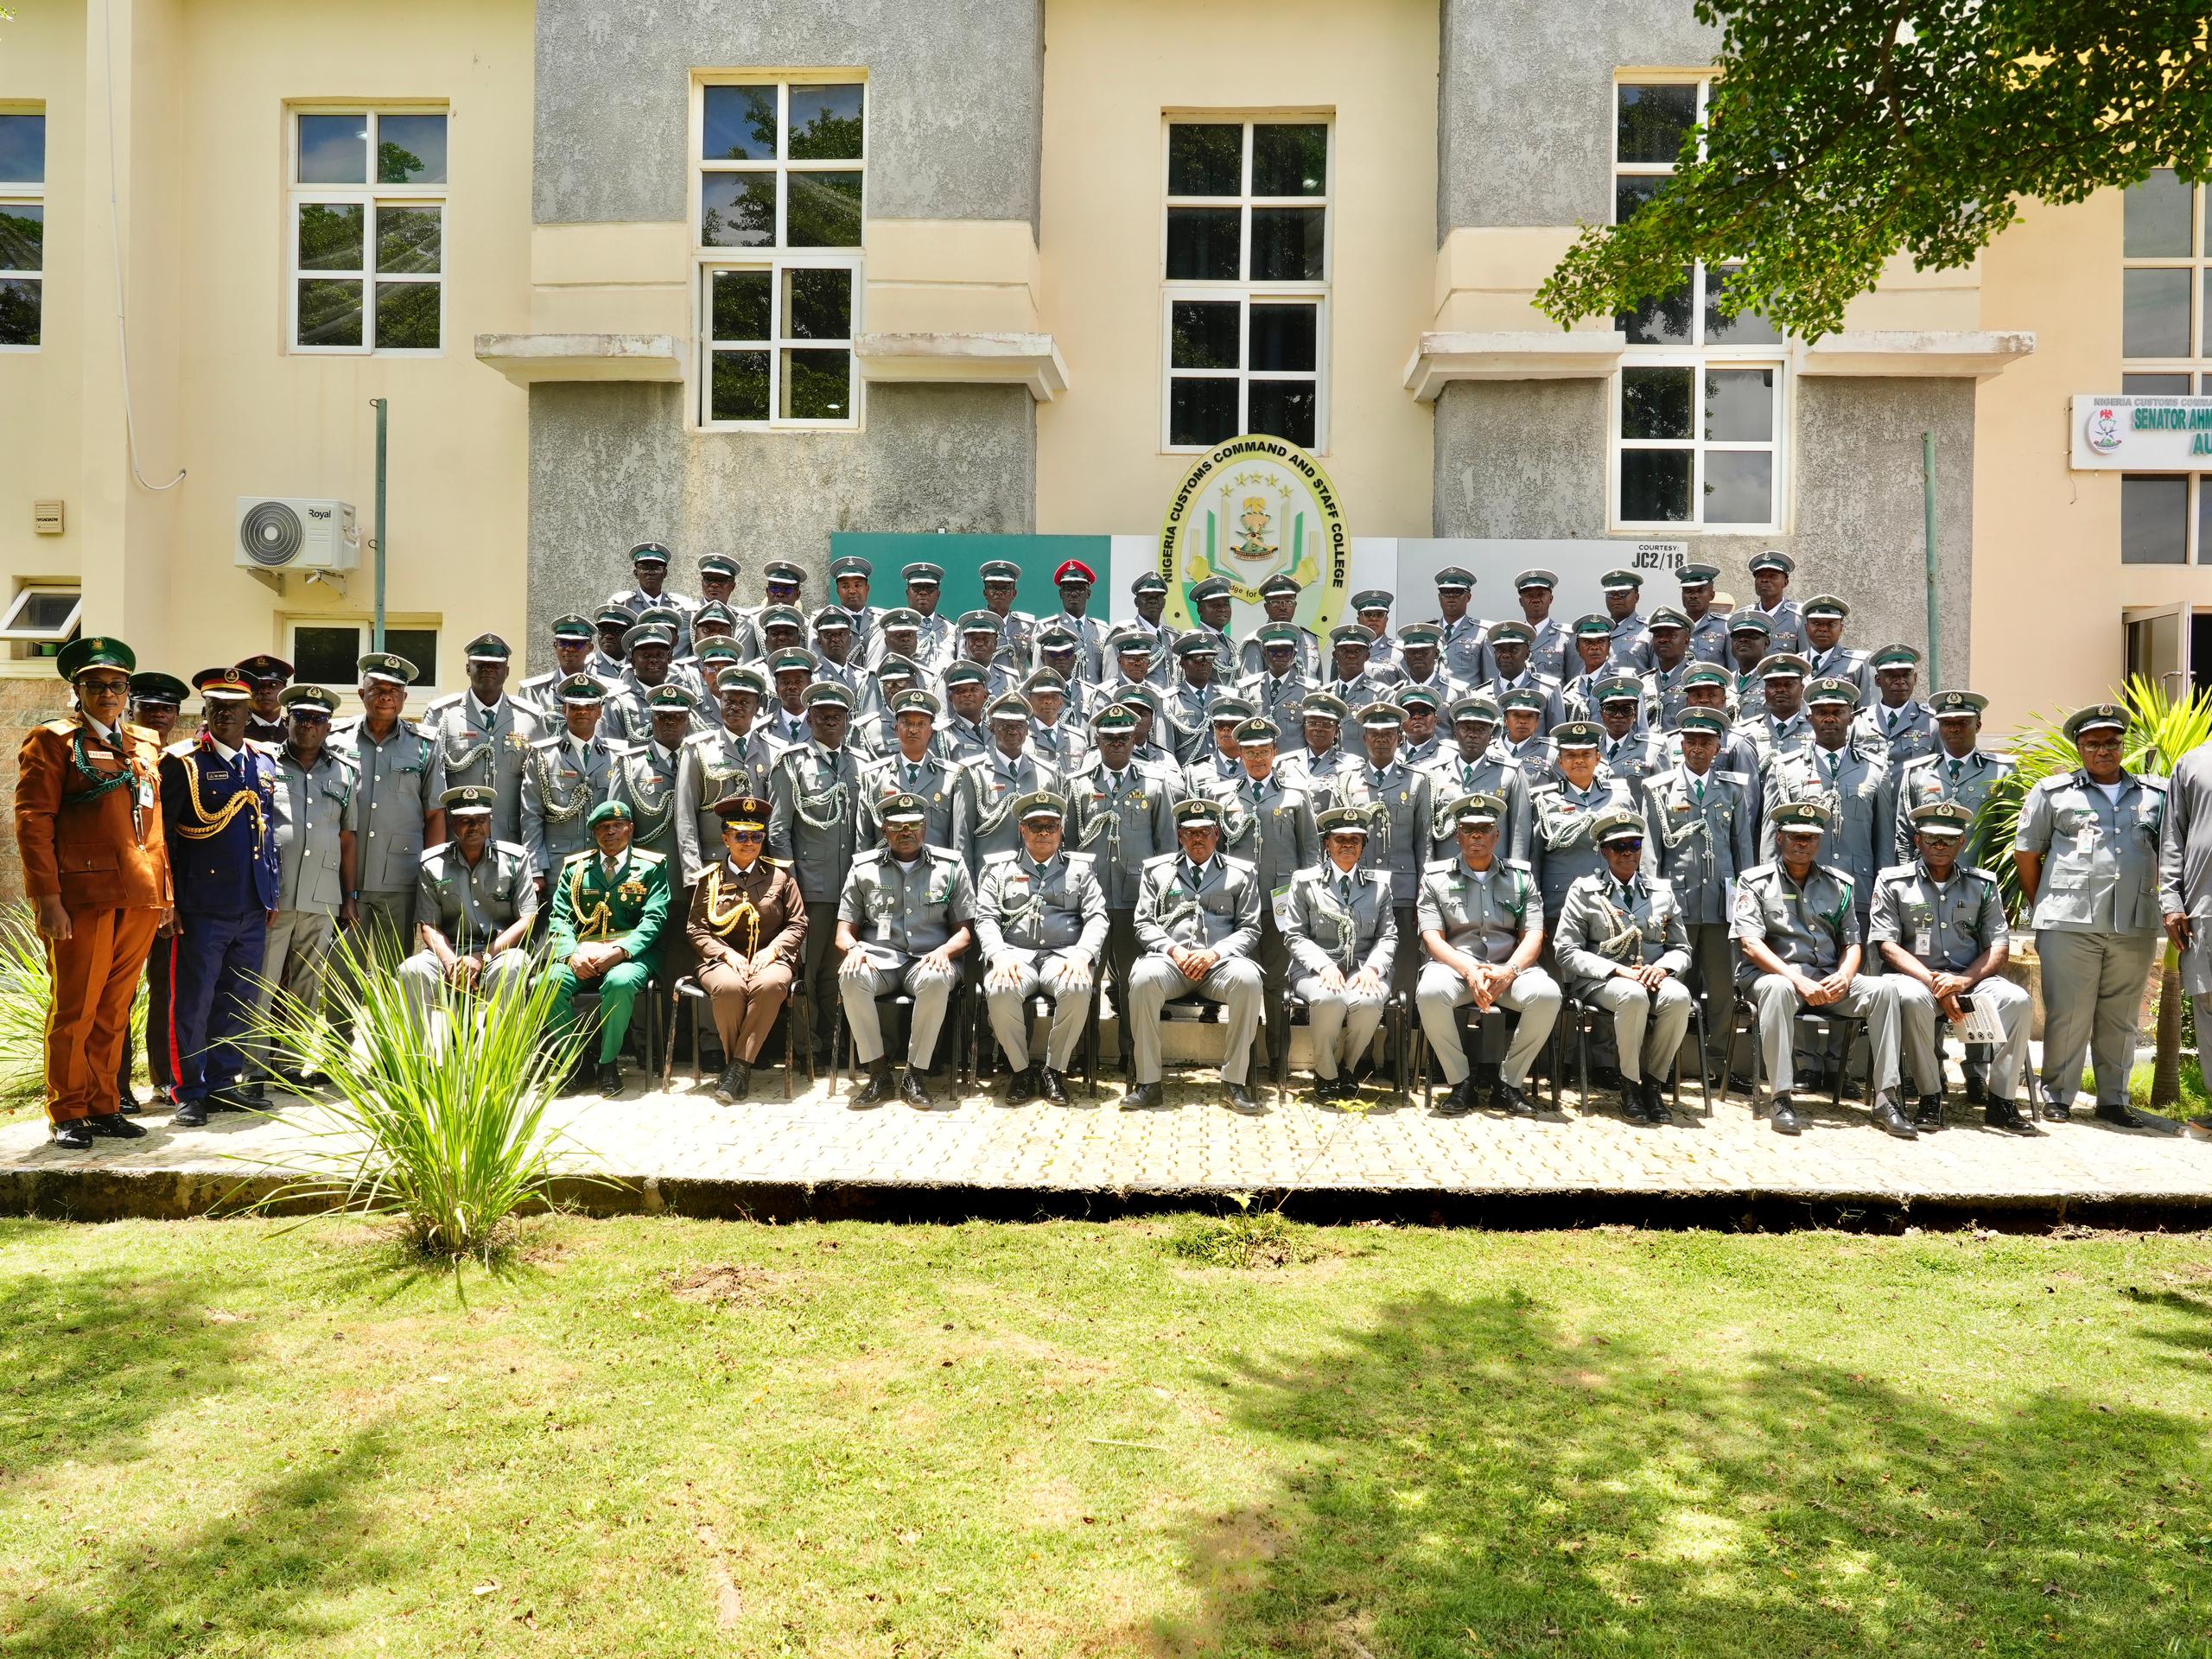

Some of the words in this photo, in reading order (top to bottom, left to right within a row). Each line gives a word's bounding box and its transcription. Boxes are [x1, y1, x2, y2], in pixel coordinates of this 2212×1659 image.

[2094, 397, 2133, 406] NIGERIA
[2134, 397, 2178, 407] CUSTOMS
[2134, 408, 2186, 429] SENATOR
[308, 509, 332, 520] Royal
[1162, 526, 1177, 583] NIGERIA
[1170, 461, 1212, 522] CUSTOMS
[1213, 441, 1287, 463] COMMAND
[1288, 454, 1316, 478] AND
[1313, 478, 1339, 518] STAFF
[1332, 523, 1345, 588] COLLEGE
[1631, 552, 1684, 570] JC2/18
[1246, 589, 1257, 598] for
